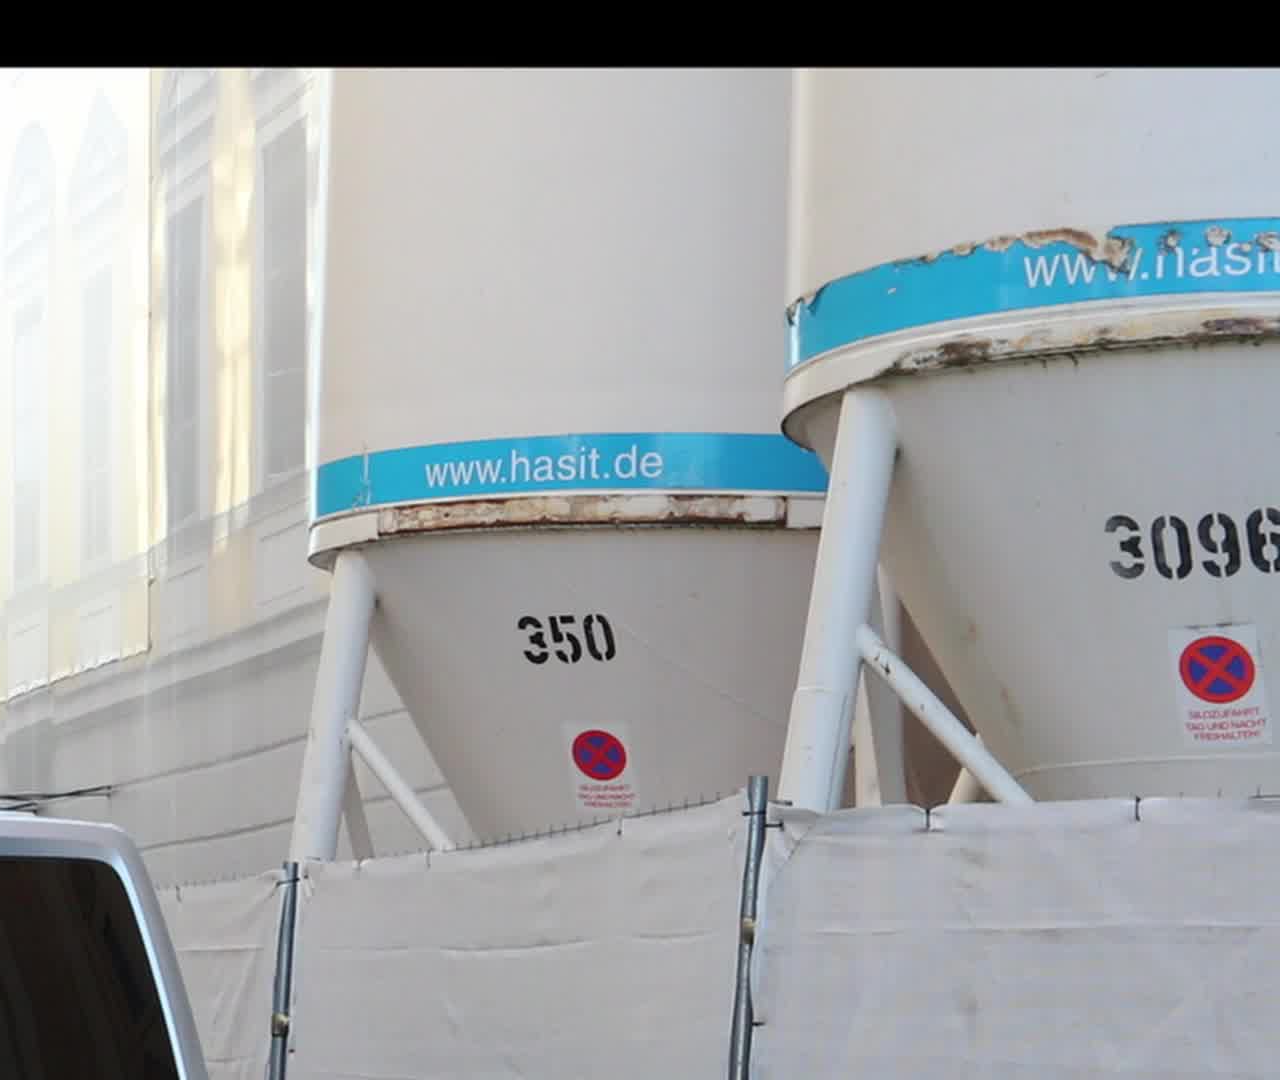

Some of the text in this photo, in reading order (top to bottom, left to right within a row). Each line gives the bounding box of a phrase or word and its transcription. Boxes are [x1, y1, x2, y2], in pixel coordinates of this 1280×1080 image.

[425, 445, 663, 488] www.hasit.de
[1104, 506, 1280, 580] 3096
[518, 613, 616, 665] 350
